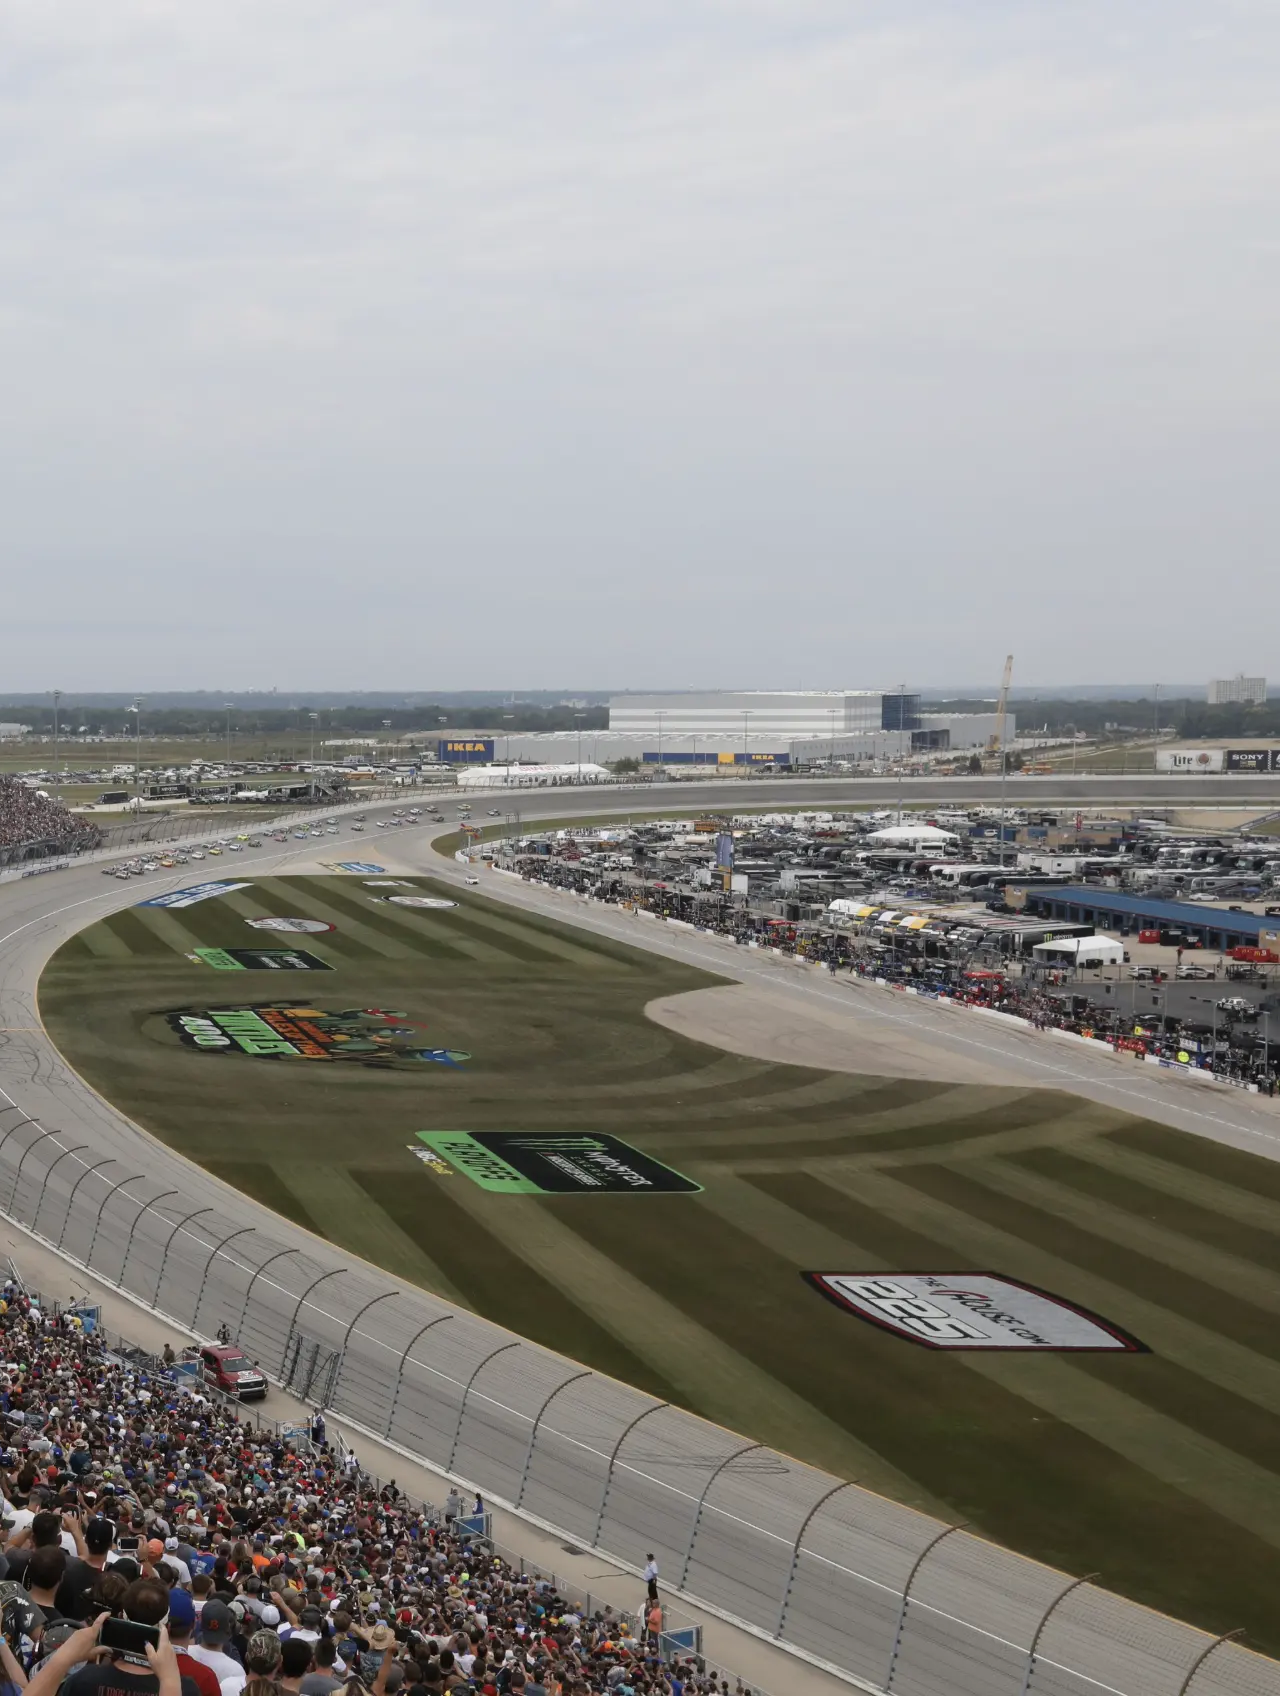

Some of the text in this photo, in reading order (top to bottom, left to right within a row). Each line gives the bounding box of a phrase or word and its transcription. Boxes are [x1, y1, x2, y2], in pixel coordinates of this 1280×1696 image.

[447, 743, 485, 752] IKEA
[1173, 753, 1193, 767] Lite
[179, 1016, 231, 1046] 400
[207, 1010, 300, 1054] TURTLES
[437, 1141, 520, 1181] PLAYOFFS
[570, 1156, 615, 1181] ENERGY
[584, 1151, 654, 1186] MONSTER
[916, 1276, 948, 1289] THE
[834, 1280, 992, 1339] 225
